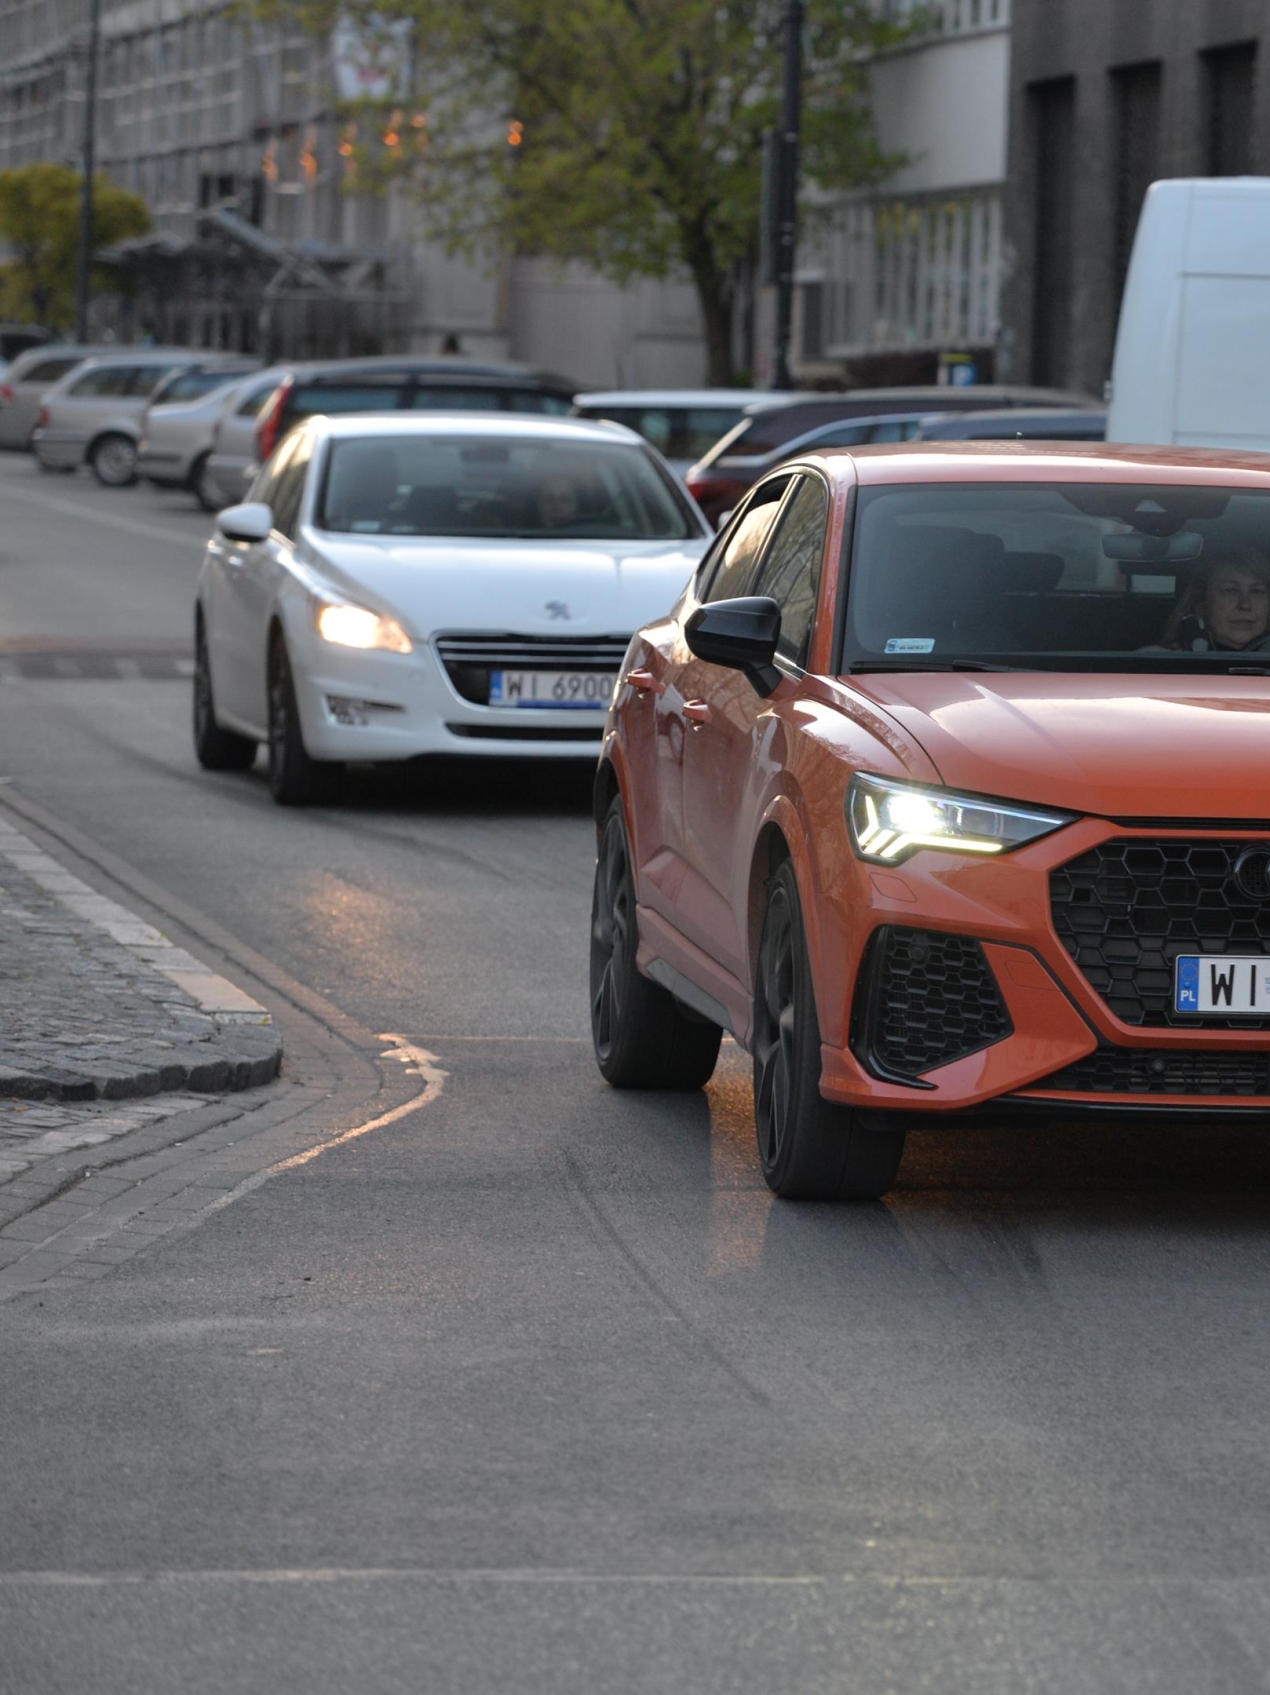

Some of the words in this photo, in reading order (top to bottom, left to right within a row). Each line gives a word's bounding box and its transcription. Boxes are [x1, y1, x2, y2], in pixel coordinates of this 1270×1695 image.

[506, 674, 537, 698] WI
[1180, 990, 1196, 1002] PL
[1210, 963, 1257, 1007] WI
